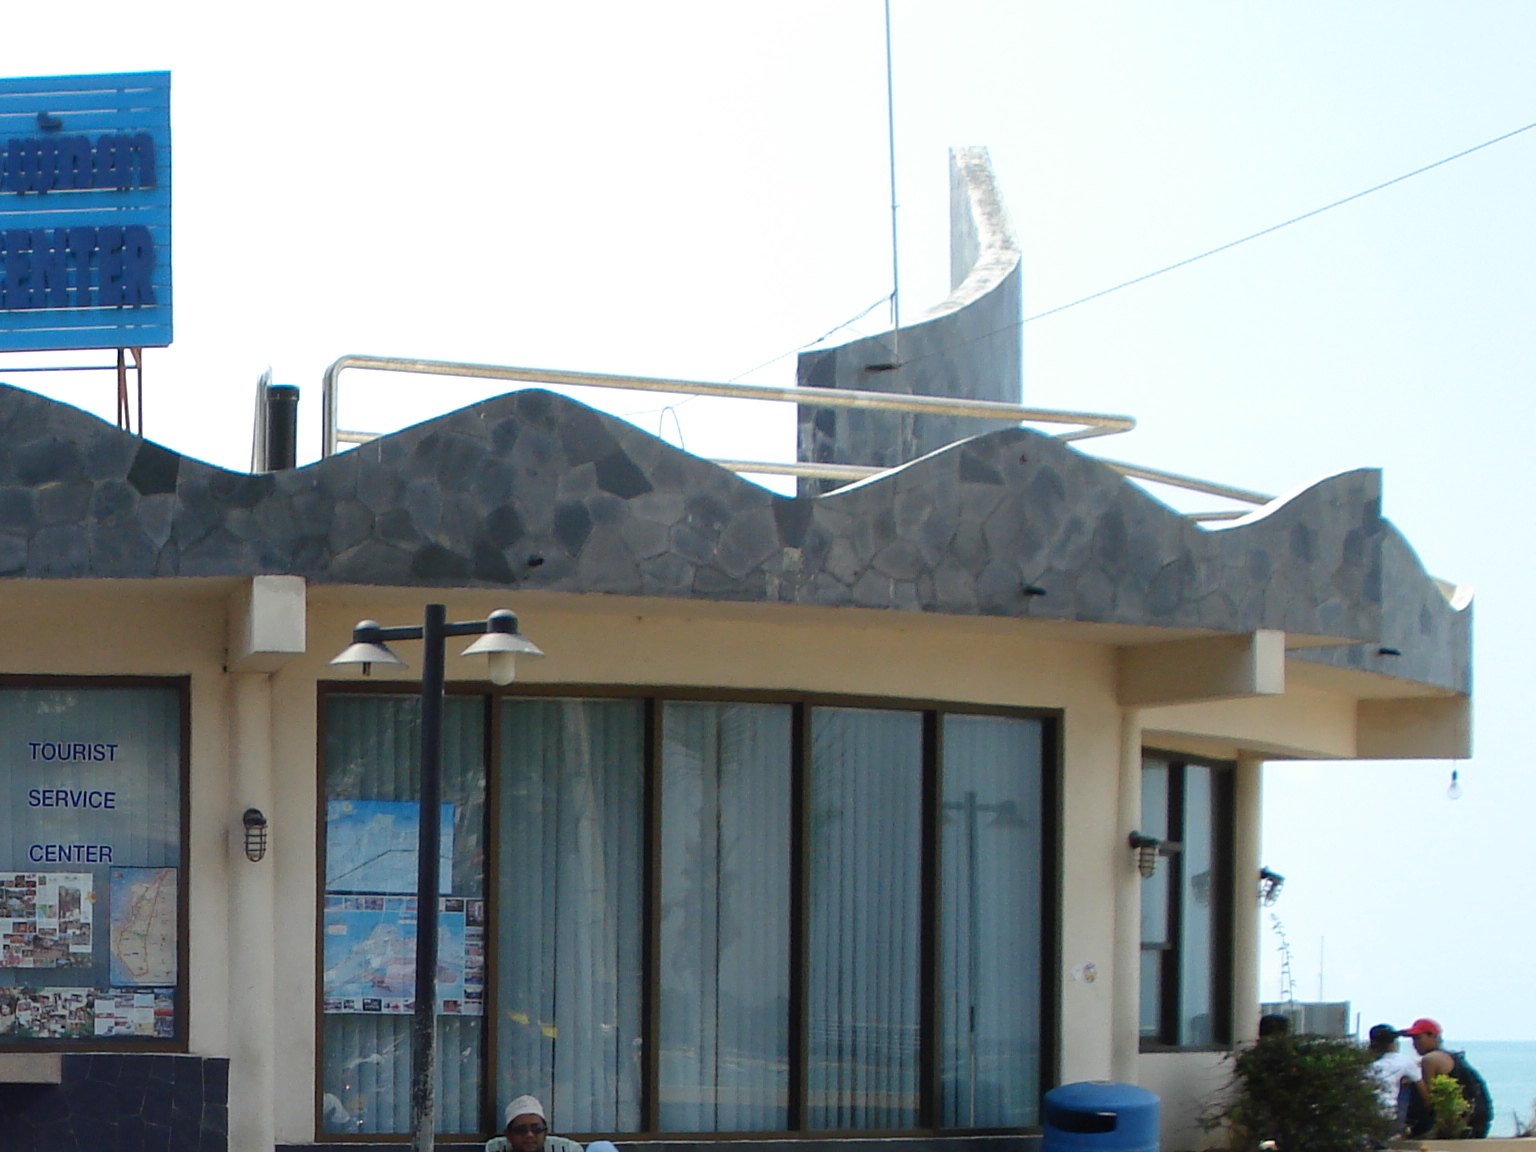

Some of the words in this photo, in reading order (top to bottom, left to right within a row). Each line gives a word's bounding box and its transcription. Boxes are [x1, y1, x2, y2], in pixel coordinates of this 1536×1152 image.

[28, 742, 119, 763] TOURIST
[28, 790, 116, 811] SERVICE
[29, 845, 114, 864] CENTER
